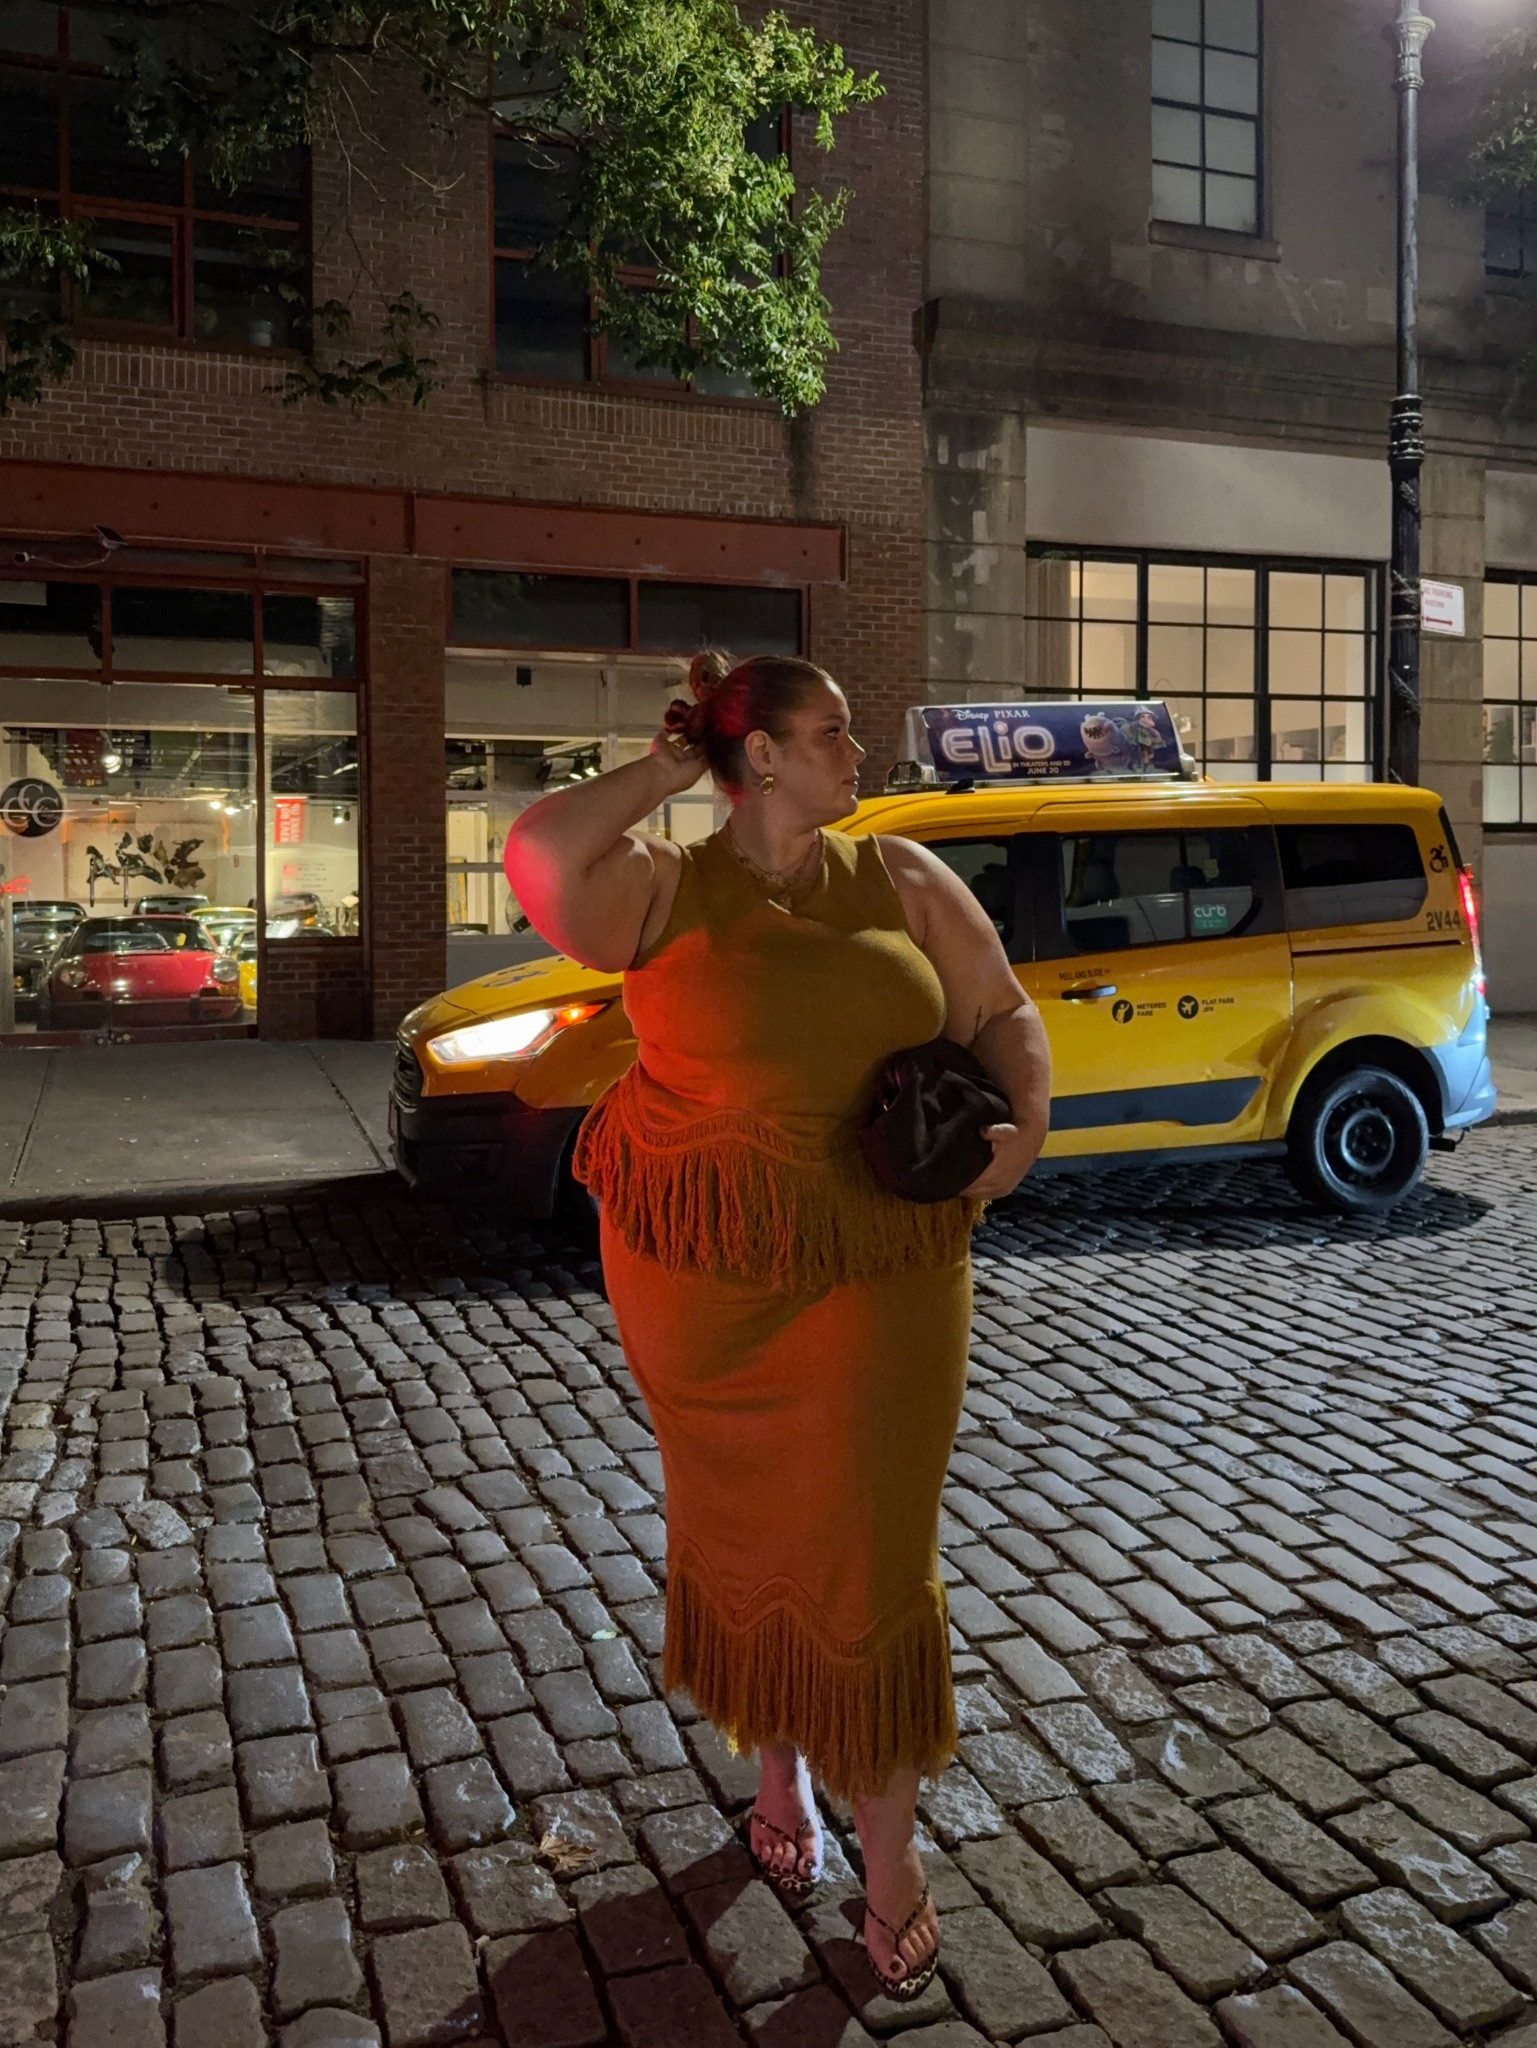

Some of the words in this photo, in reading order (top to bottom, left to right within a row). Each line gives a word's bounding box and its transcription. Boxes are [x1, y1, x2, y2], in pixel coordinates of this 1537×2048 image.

[994, 709, 1031, 719] PIXAR
[1027, 767, 1047, 775] JUNE
[1049, 766, 1060, 774] 20
[1193, 904, 1227, 918] curb
[1426, 910, 1461, 930] 2V44
[1136, 1002, 1167, 1010] METERED
